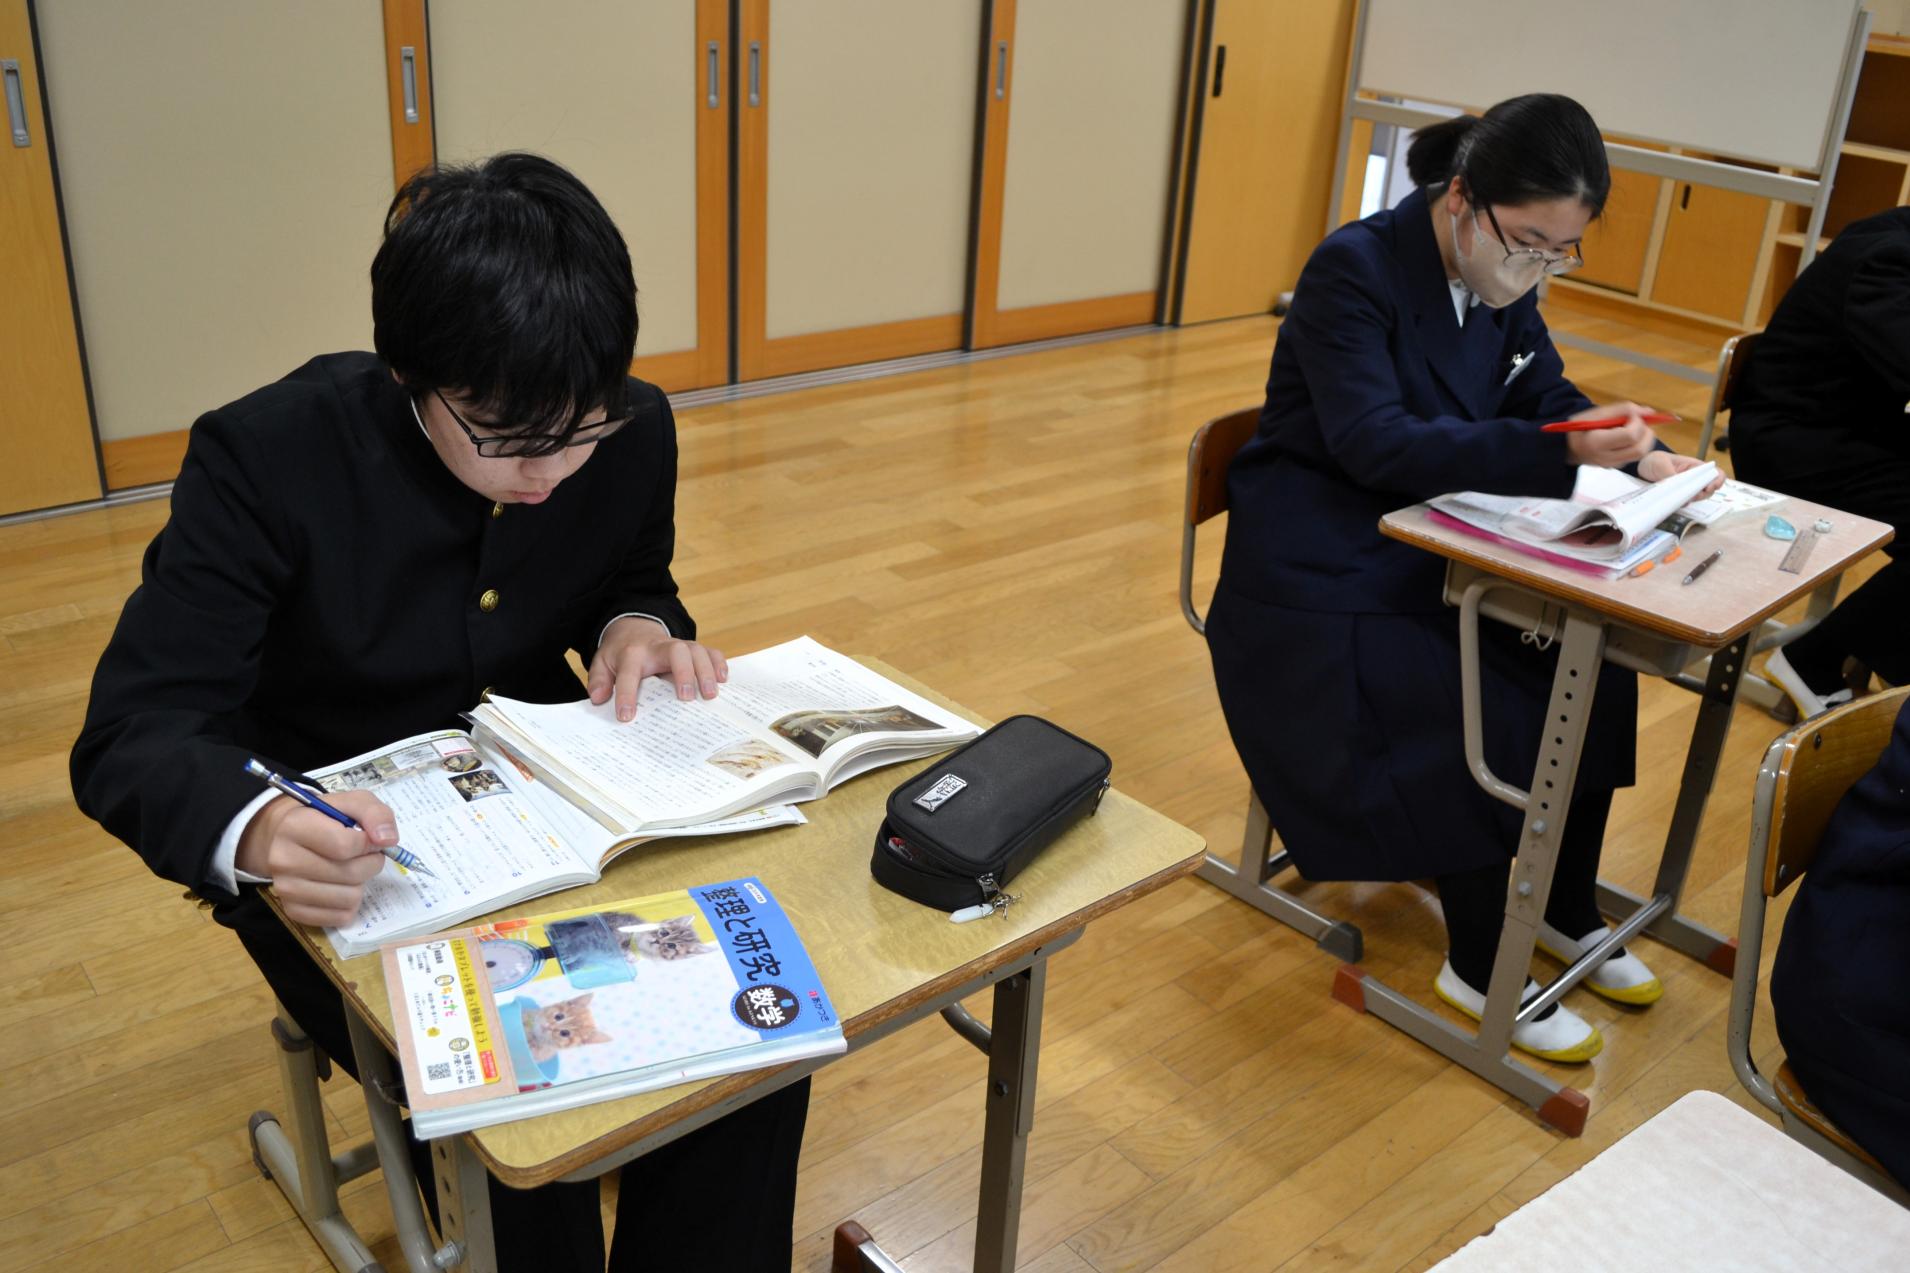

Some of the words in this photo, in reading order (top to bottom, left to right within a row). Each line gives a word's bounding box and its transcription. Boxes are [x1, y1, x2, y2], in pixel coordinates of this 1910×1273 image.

[701, 886, 781, 981] 整理と研究
[747, 987, 786, 1026] 数学
[812, 997, 830, 1022] あかつき
